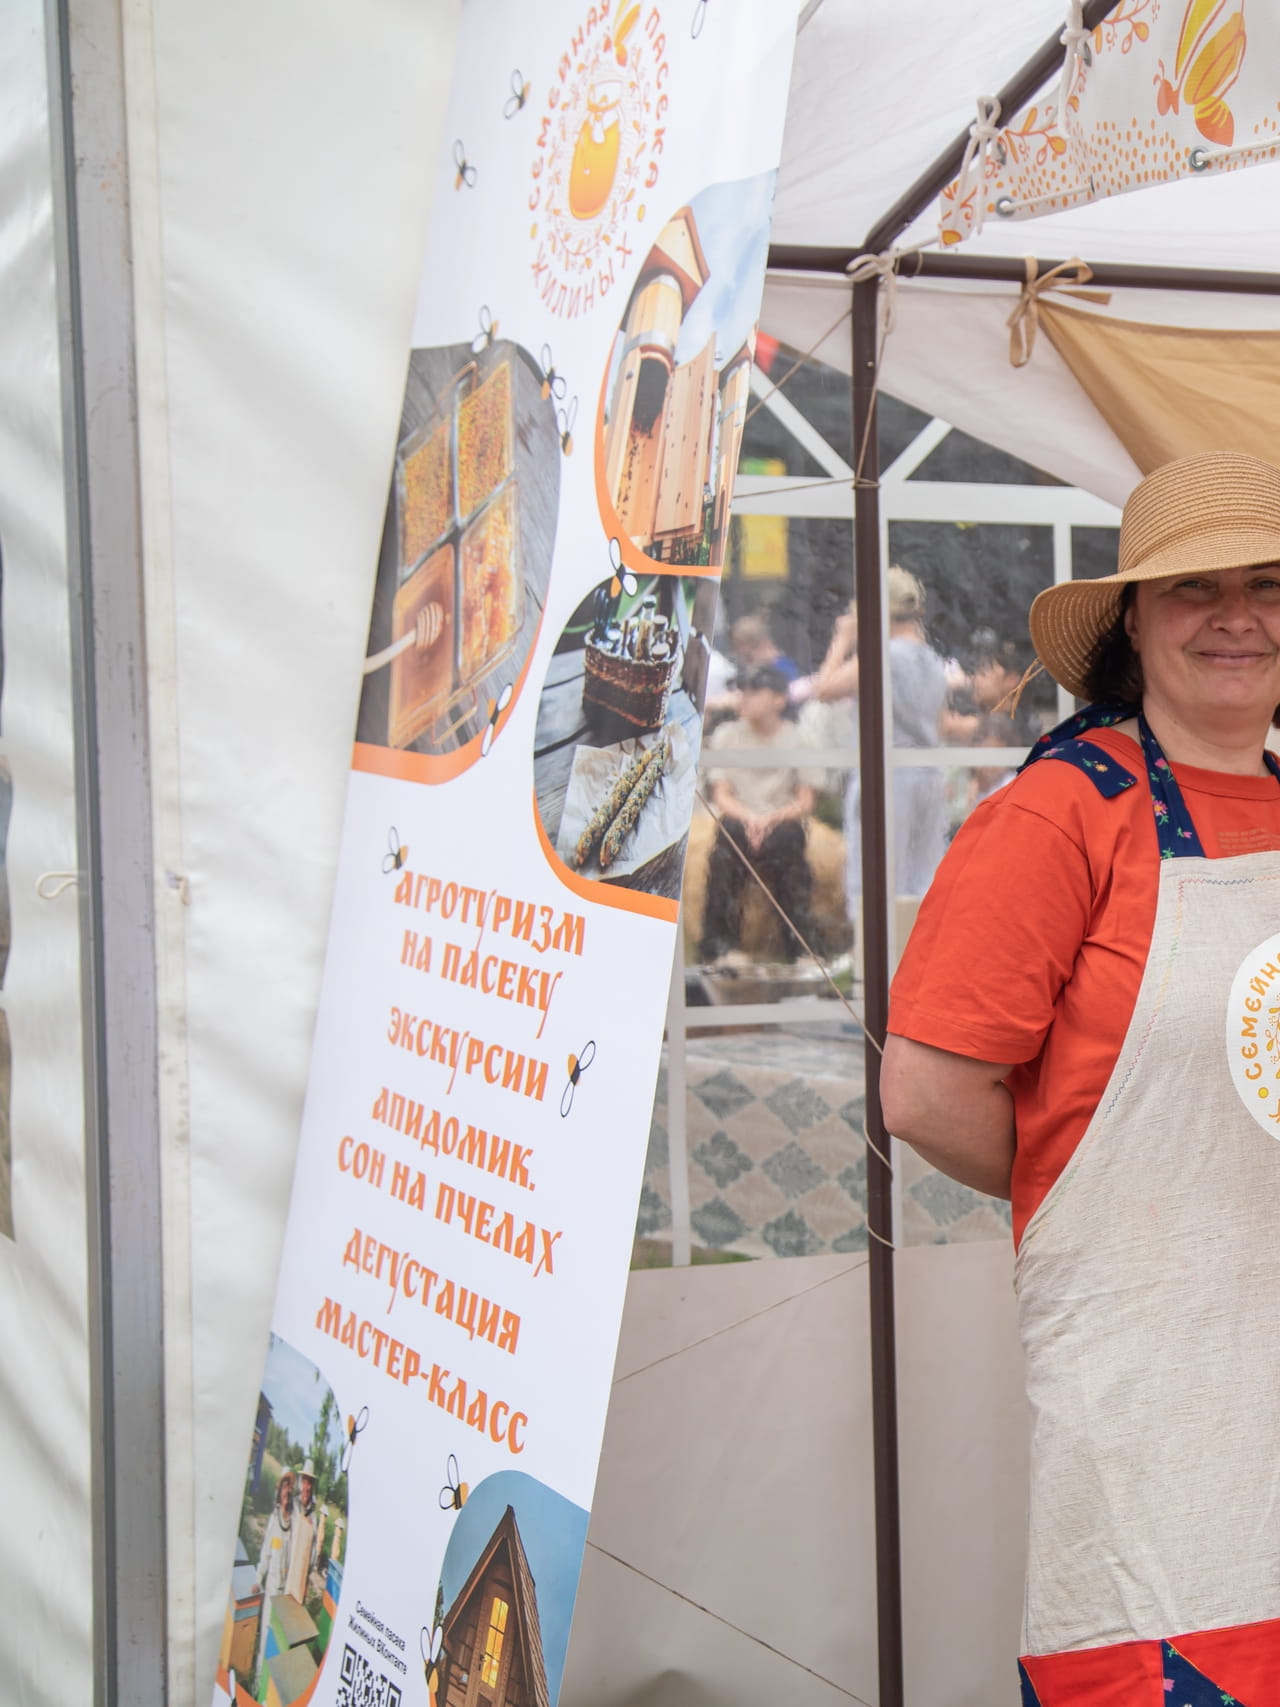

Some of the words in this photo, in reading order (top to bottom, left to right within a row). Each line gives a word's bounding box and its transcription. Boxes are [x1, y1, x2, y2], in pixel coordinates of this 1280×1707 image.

[644, 5, 669, 189] ПАСЕКА
[530, 233, 632, 320] ЖИЛИНЫХ
[394, 868, 587, 957] АГРОТУРИЗМ
[400, 928, 432, 974] НА
[441, 942, 564, 1039] ПАСЕКУ
[386, 1005, 550, 1102] ЭКСКУРСИИ
[371, 1085, 537, 1192] АПИДОМИК.
[337, 1134, 387, 1190] СОН
[391, 1157, 427, 1212] НА
[434, 1181, 563, 1279] ПЧЕЛАХ
[342, 1226, 522, 1355] ДЕГУСТАЦИЯ
[314, 1295, 529, 1455] МАСТЕР-КЛАСС
